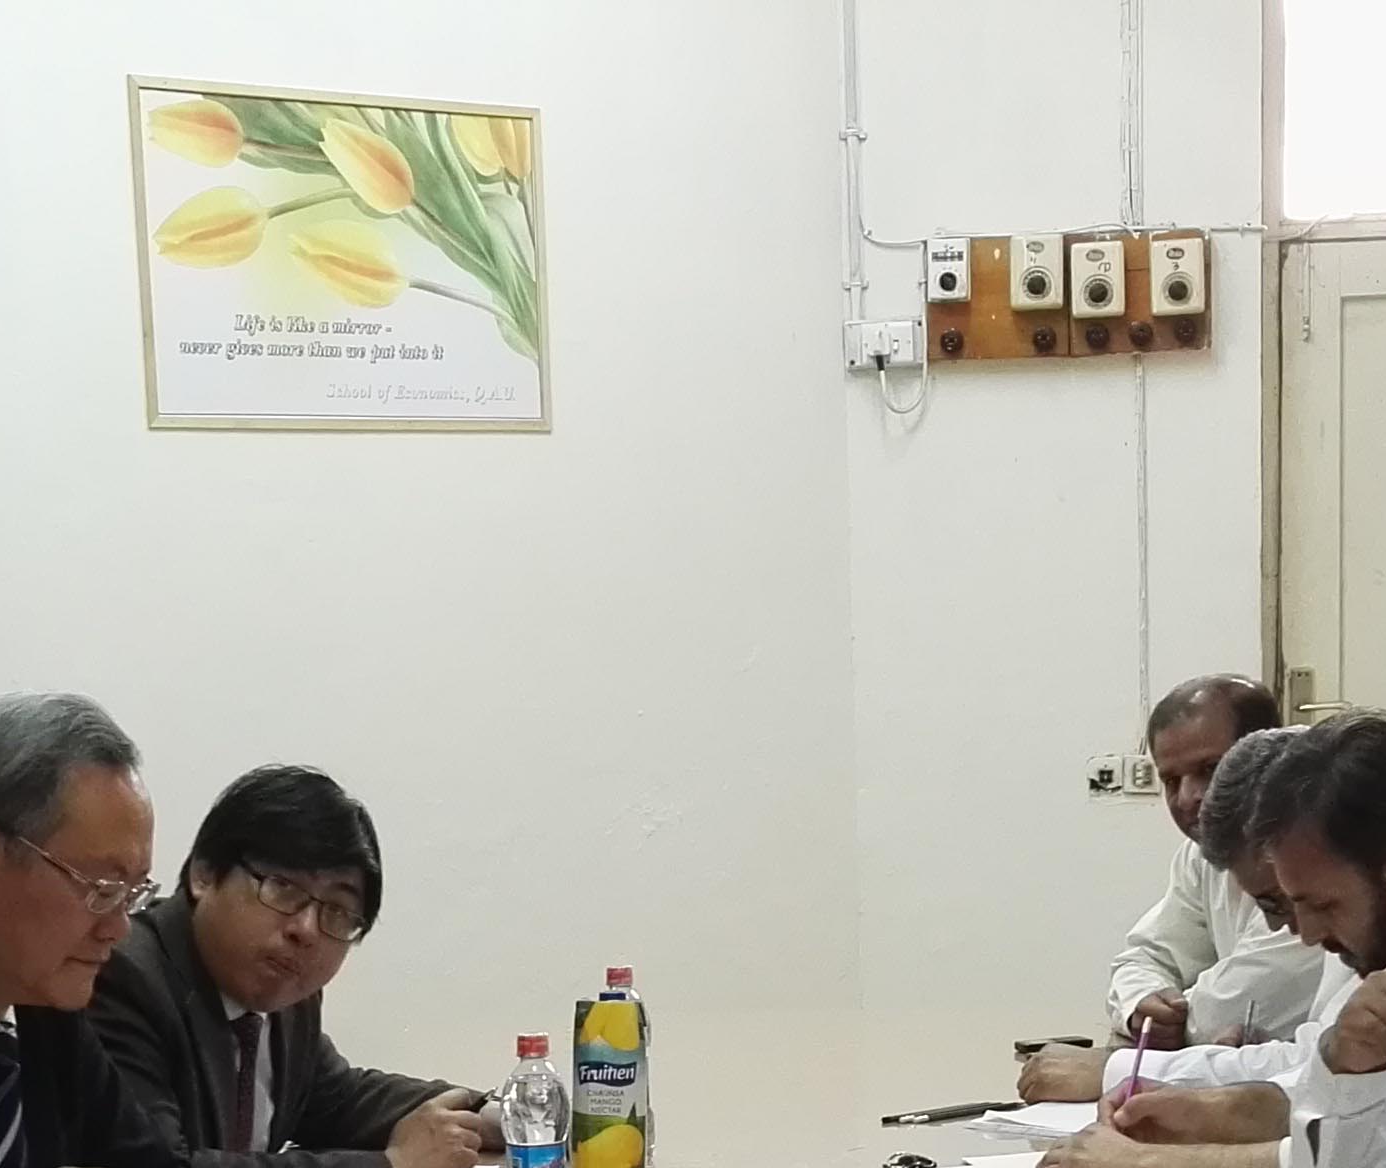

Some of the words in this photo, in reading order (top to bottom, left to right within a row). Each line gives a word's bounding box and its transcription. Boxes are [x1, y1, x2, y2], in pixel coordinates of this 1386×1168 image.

[234, 314, 265, 336] Life
[269, 315, 283, 333] is
[286, 316, 314, 334] like
[318, 321, 329, 334] a
[332, 319, 382, 335] mirror
[179, 341, 222, 355] never
[226, 339, 264, 360] gives
[267, 343, 304, 357] more
[308, 341, 342, 358] than
[346, 346, 366, 359] we
[370, 343, 395, 364] put
[399, 343, 428, 361] into
[431, 344, 444, 361] it
[326, 383, 372, 399] School
[377, 383, 393, 404] of
